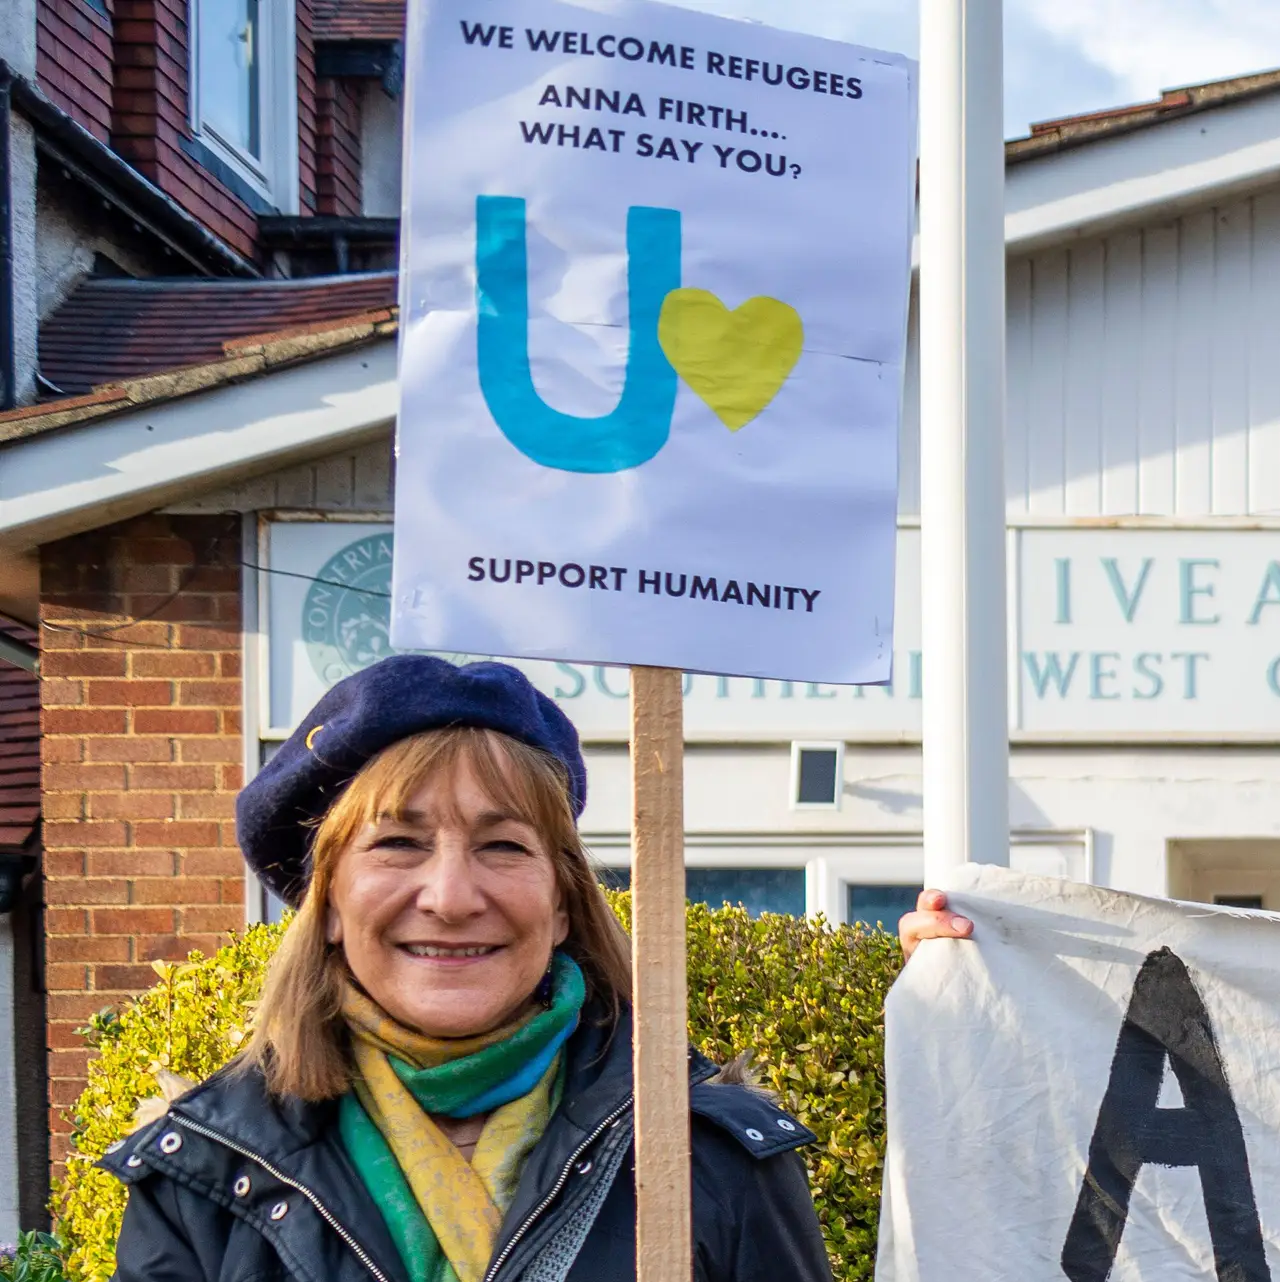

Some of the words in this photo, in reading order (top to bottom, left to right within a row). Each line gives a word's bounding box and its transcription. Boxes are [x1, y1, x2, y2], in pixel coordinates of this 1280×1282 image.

[459, 19, 514, 50] WE
[525, 28, 696, 71] WELCOME
[706, 50, 863, 100] REFUGEES
[538, 84, 647, 118] ANNA
[519, 121, 626, 154] WHAT
[636, 133, 704, 164] SAY
[712, 144, 802, 180] YOU?
[467, 556, 628, 592] SUPPORT
[638, 569, 822, 613] HUMANITY
[1022, 650, 1212, 702] WEST
